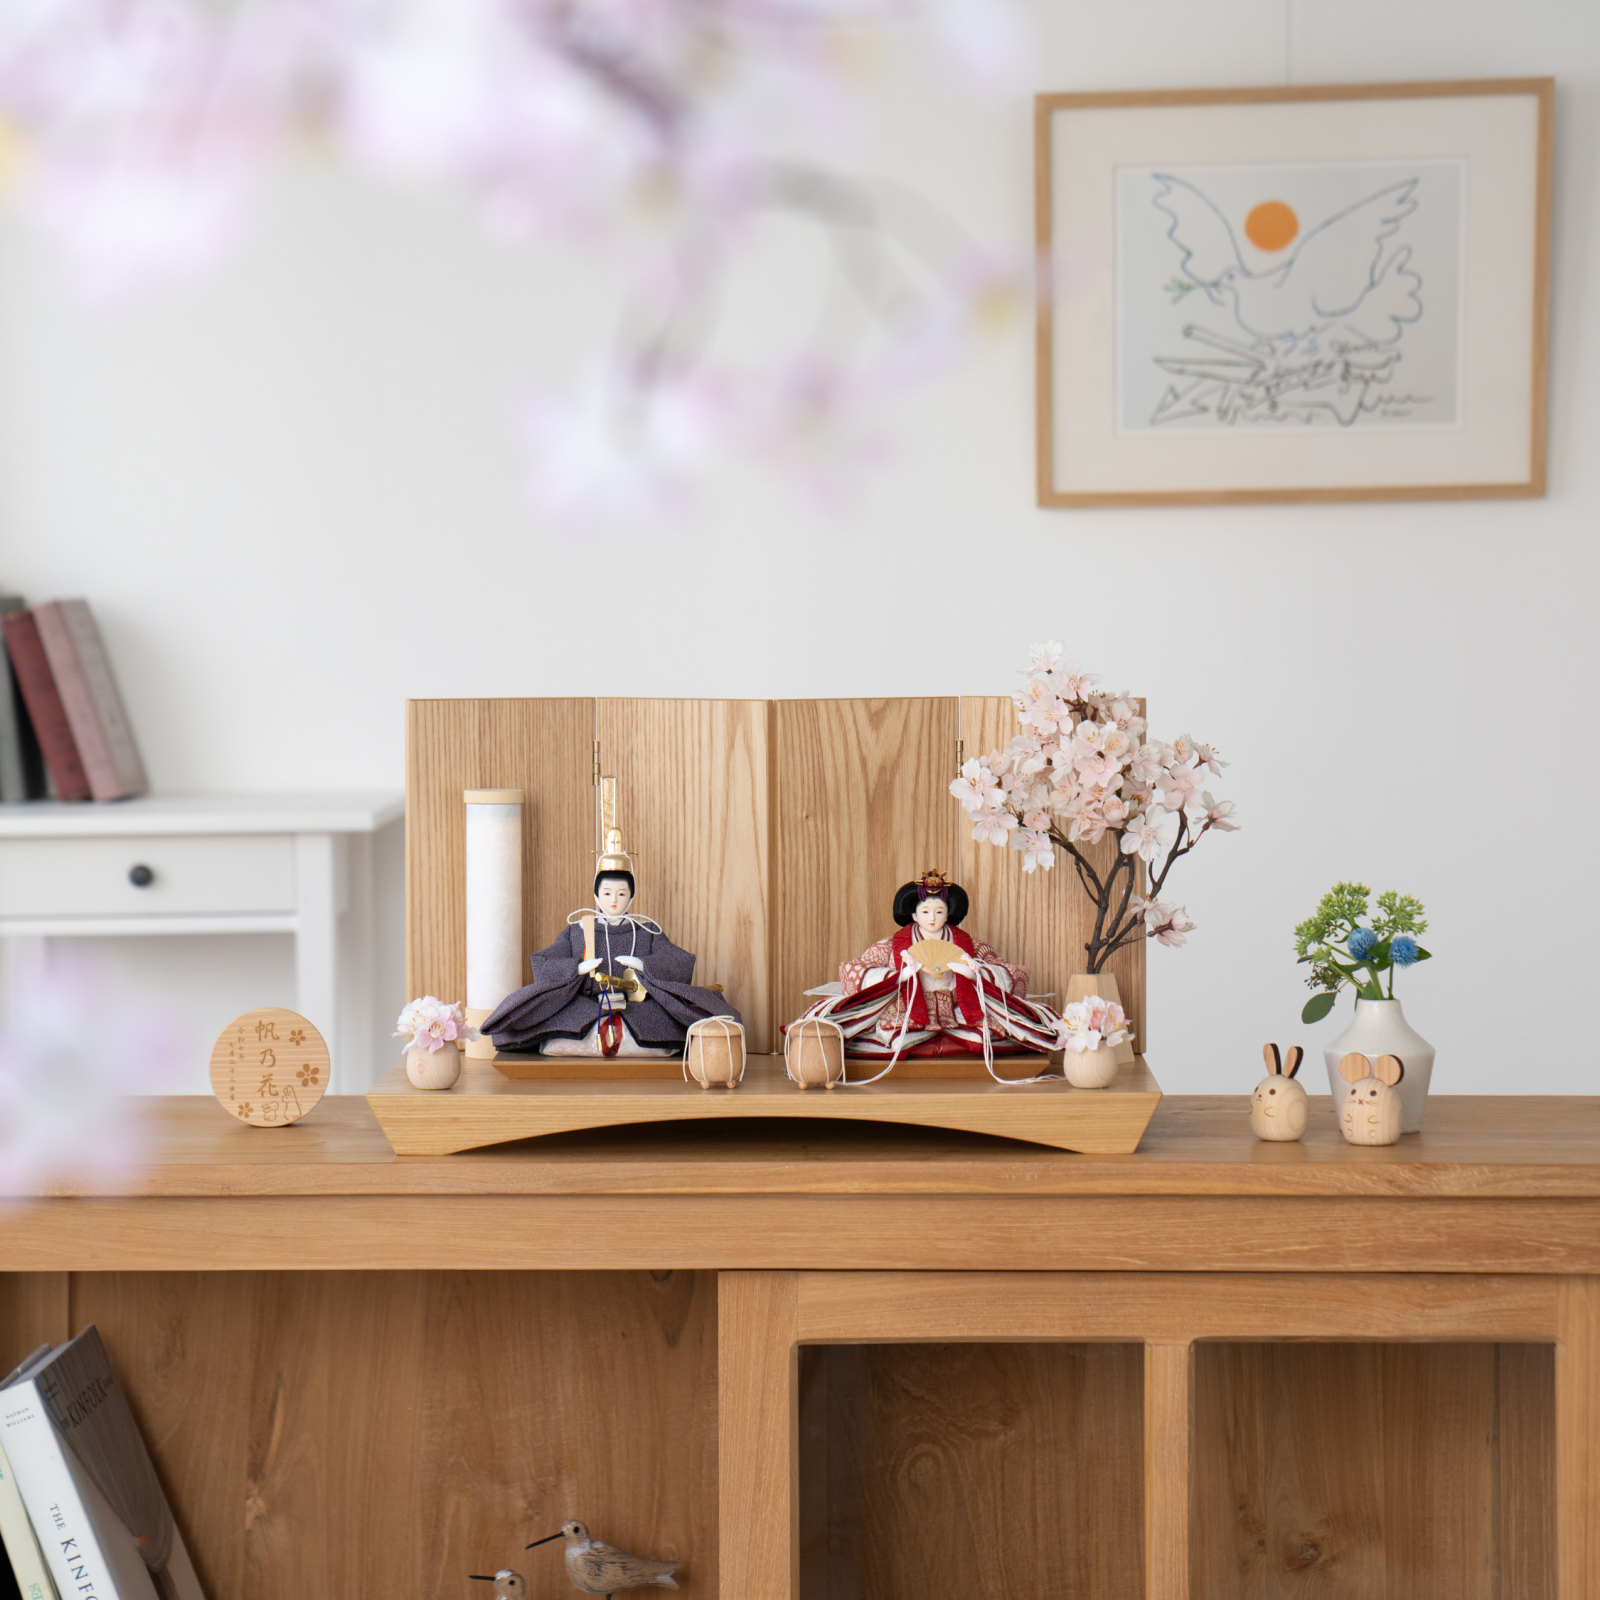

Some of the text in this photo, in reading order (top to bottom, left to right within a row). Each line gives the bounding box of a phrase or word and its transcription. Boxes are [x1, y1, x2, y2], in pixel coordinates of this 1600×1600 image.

[255, 1020, 280, 1098] 帆乃花
[5, 1407, 29, 1419] NATHAN
[6, 1414, 35, 1428] WILLIAMS
[66, 1377, 108, 1428] KINFOLK
[50, 1503, 99, 1600] THE KINF
